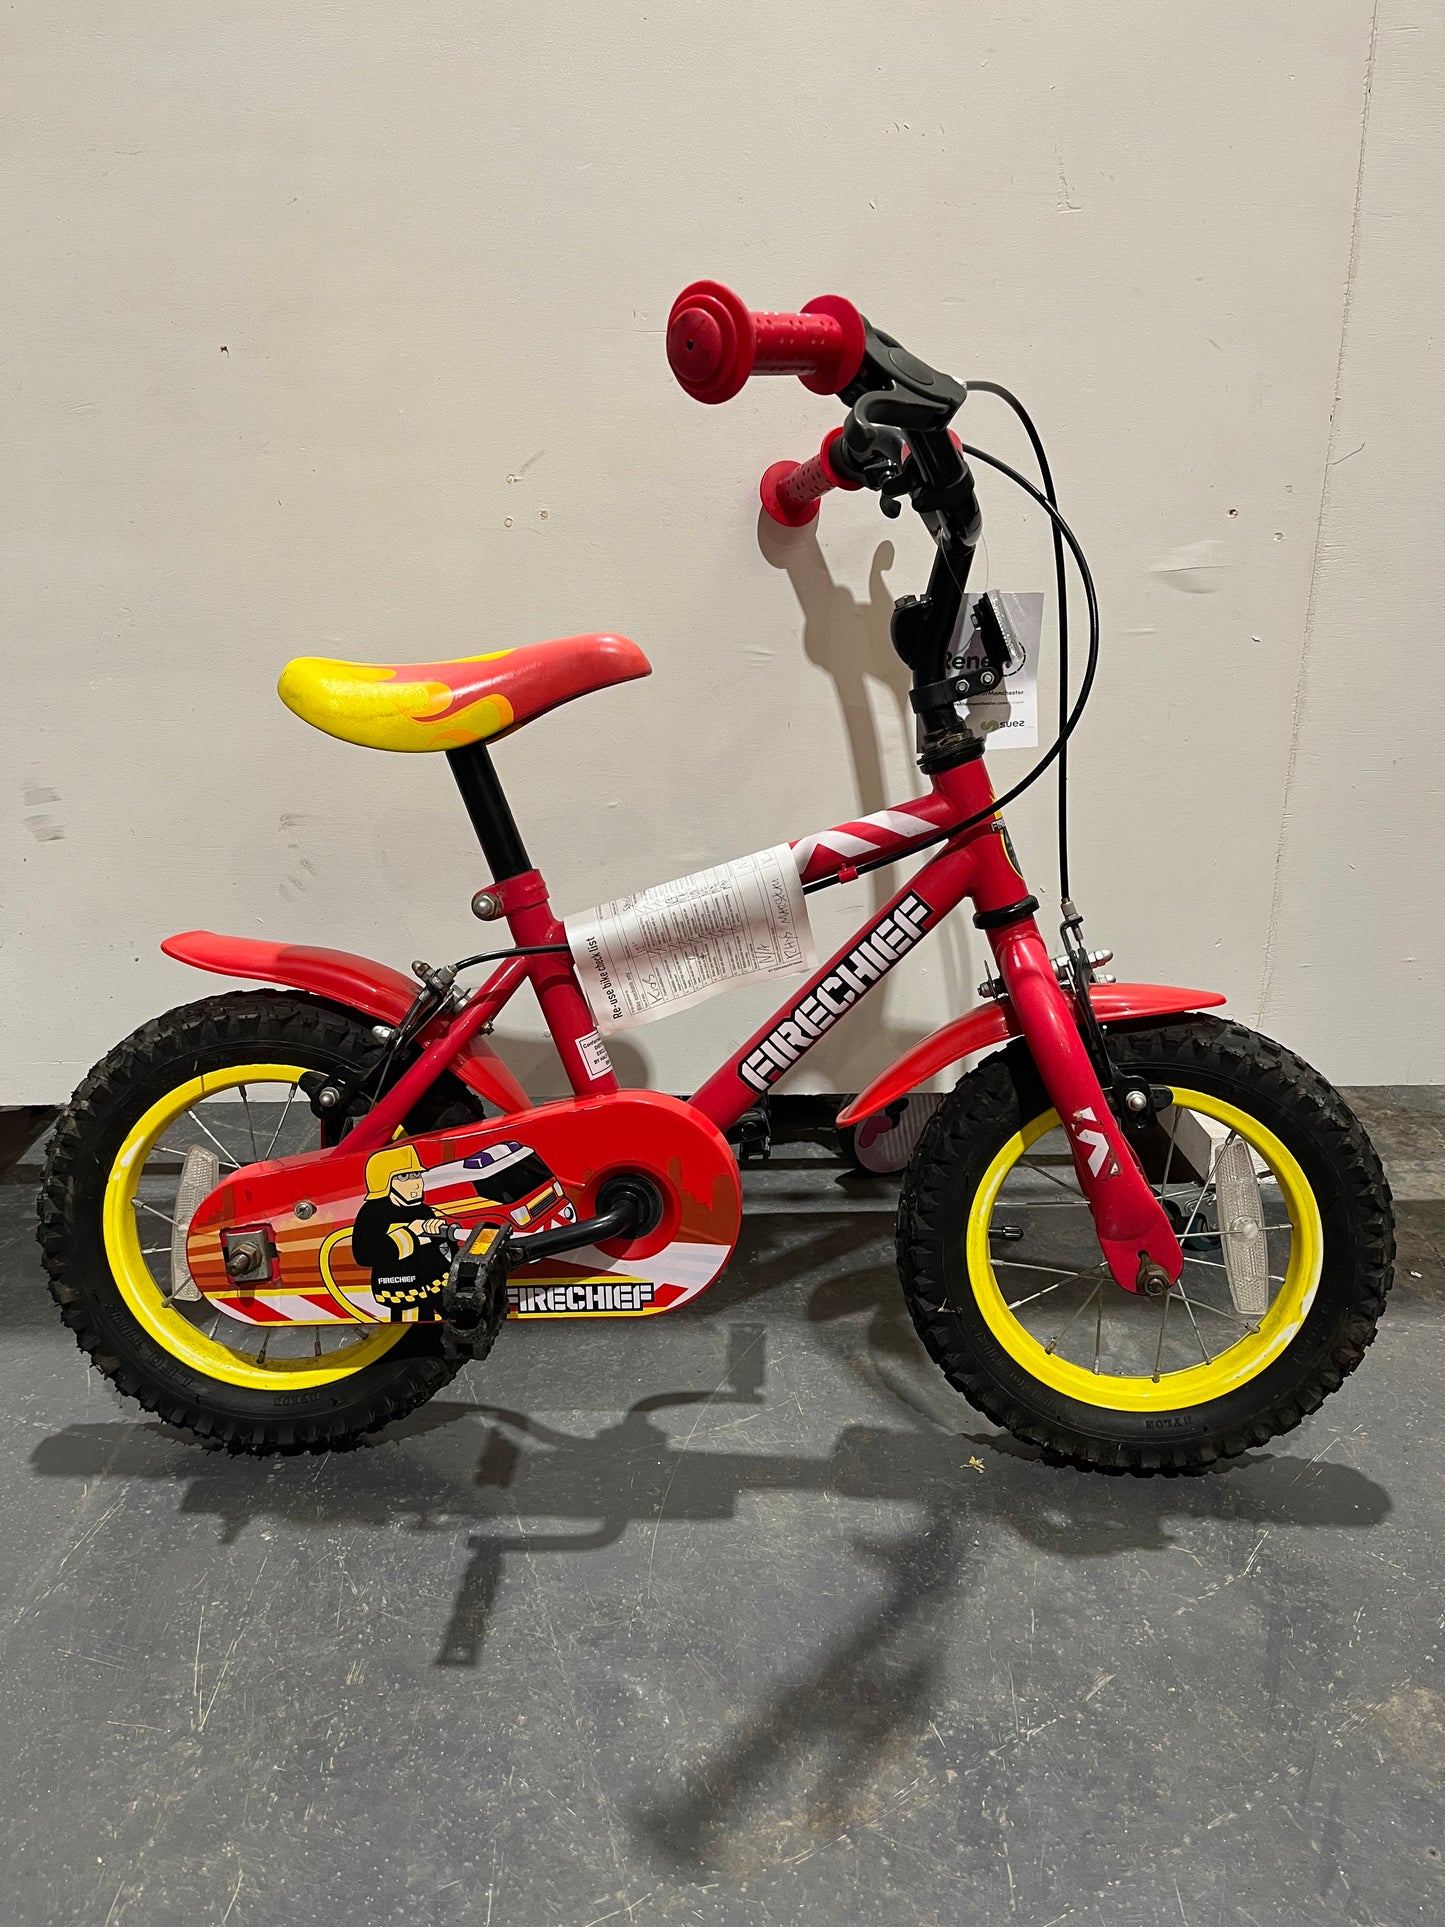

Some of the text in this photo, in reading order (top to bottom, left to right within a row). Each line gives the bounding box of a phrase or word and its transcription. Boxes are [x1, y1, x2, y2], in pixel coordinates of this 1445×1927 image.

[945, 652, 990, 670] Rene
[999, 720, 1024, 728] suez
[586, 937, 623, 1019] Re-use bike check list
[741, 895, 929, 1092] FIRECHIEF
[377, 1274, 416, 1284] FIRECHIEF
